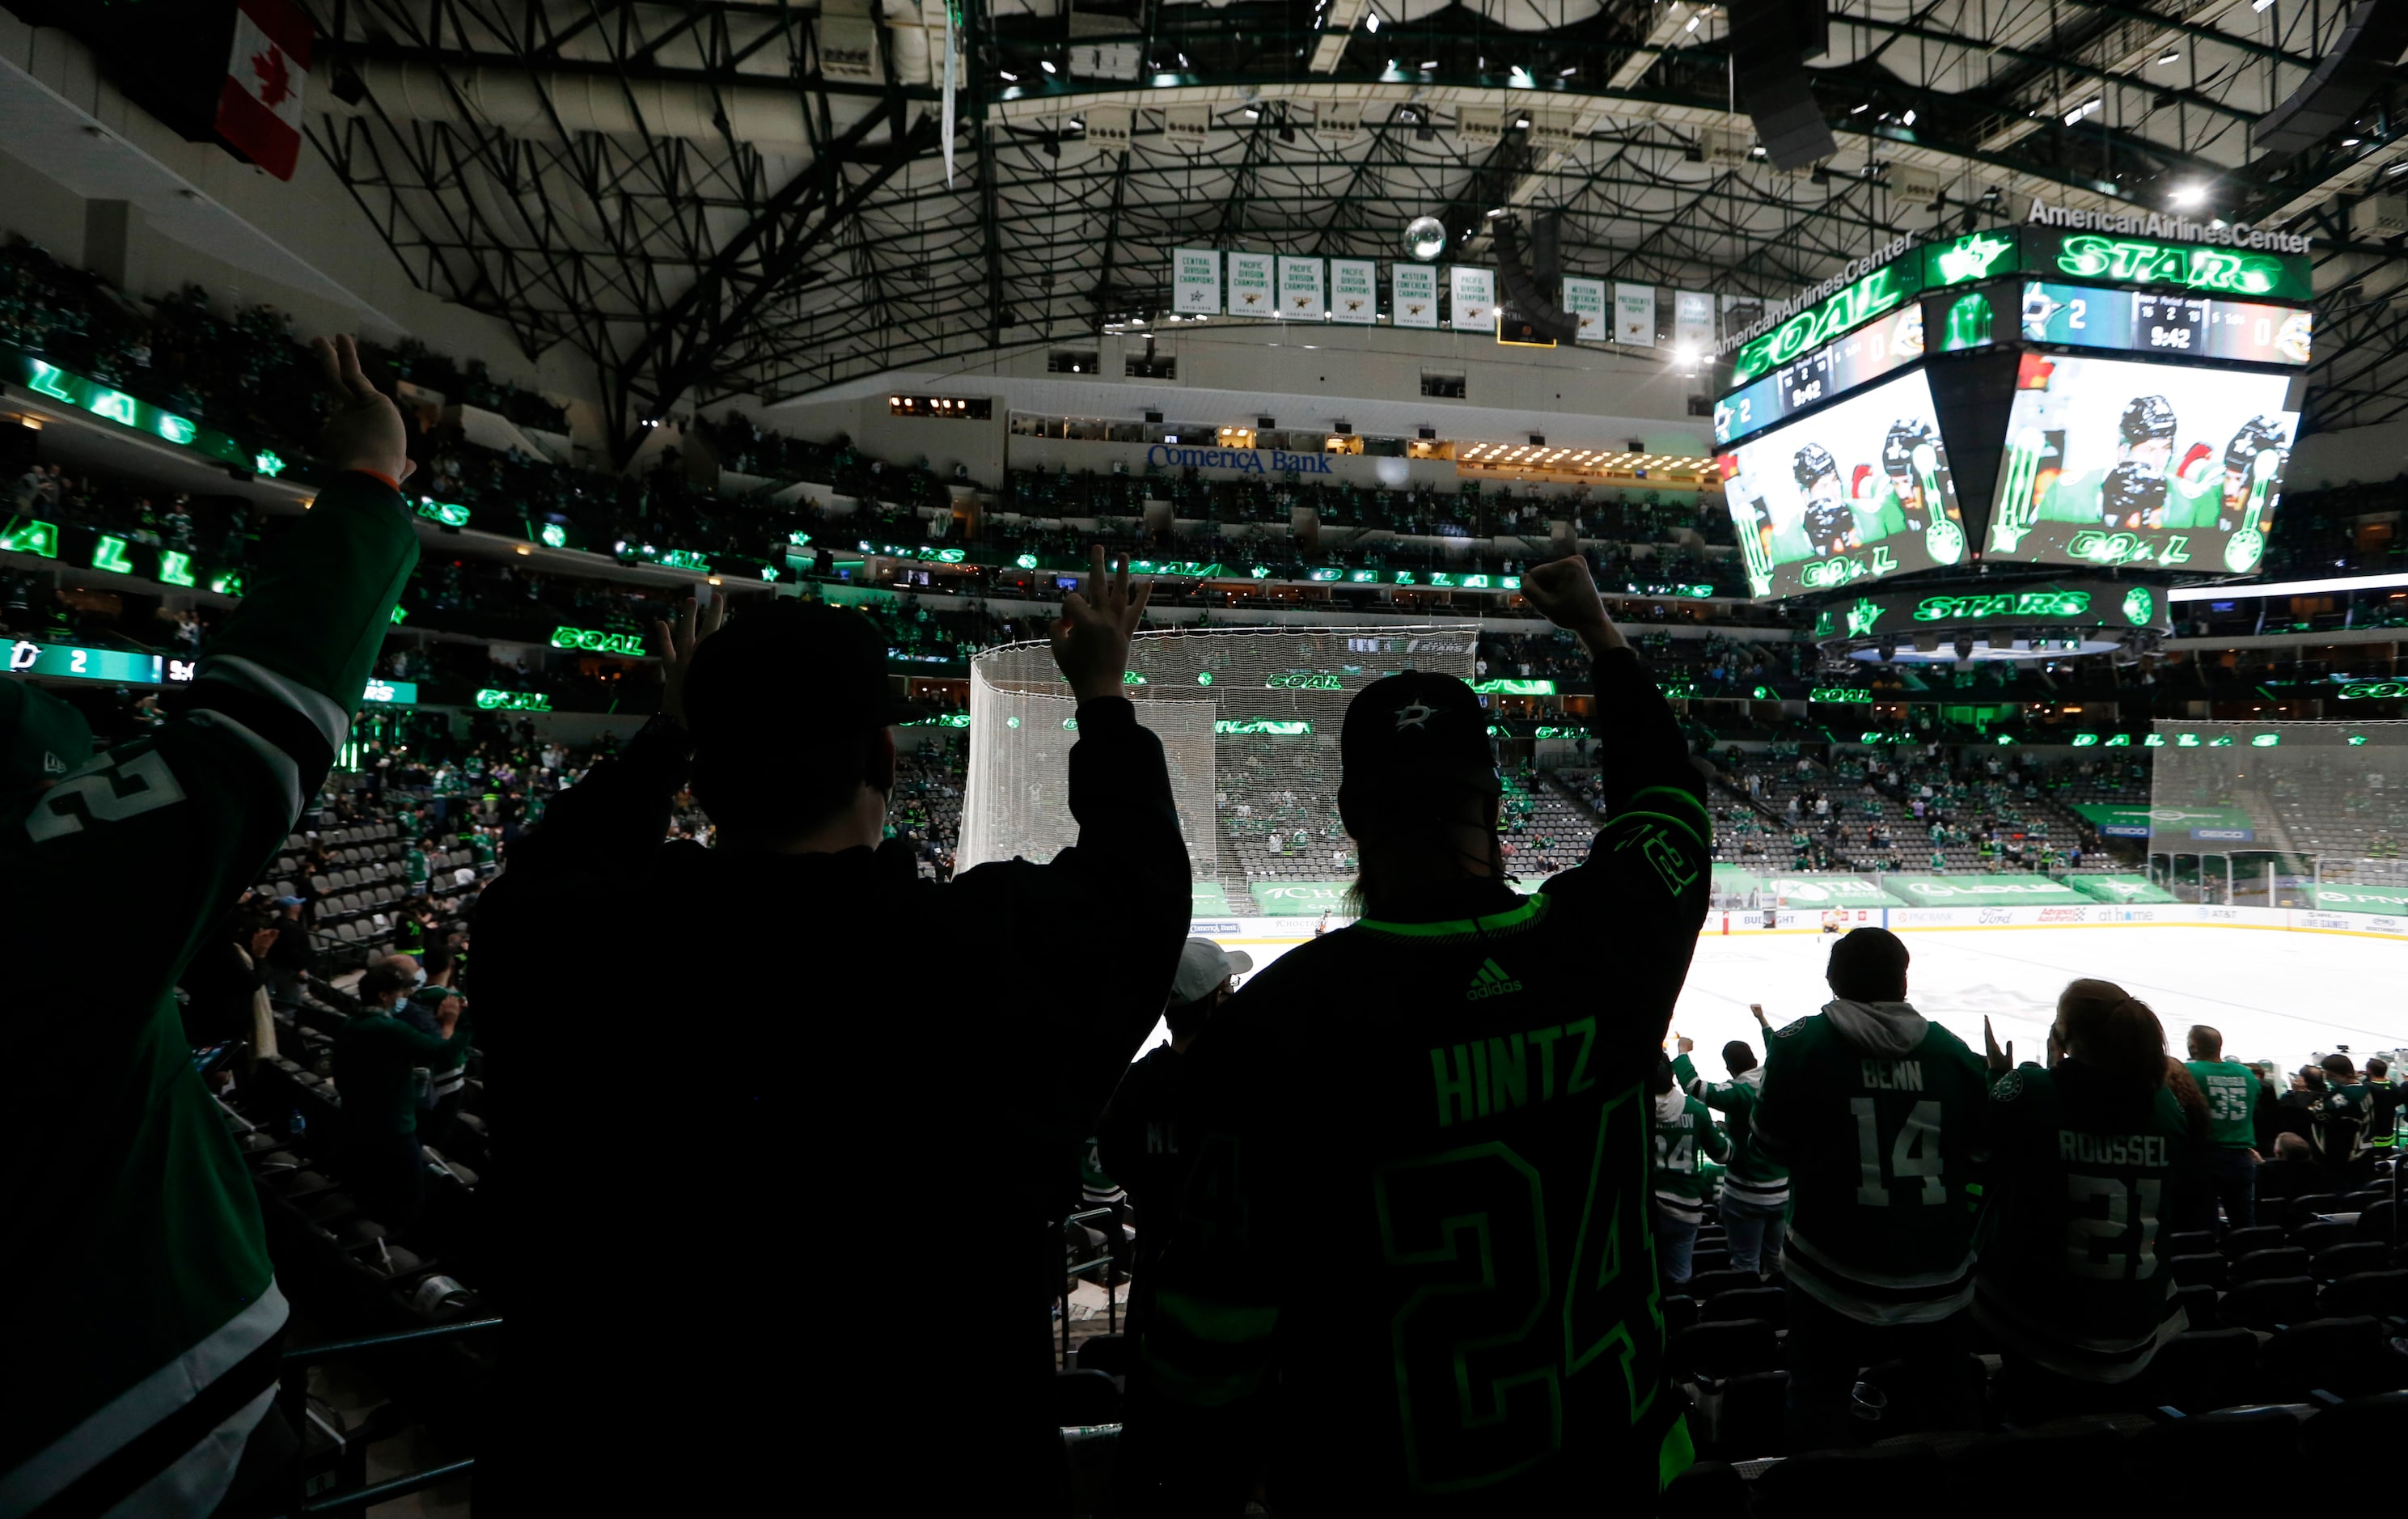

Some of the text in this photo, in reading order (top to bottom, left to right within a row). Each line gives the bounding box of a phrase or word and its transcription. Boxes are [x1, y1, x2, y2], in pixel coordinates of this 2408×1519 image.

[1183, 257, 1210, 266] CENTRAL
[1239, 260, 1263, 269] PACIFIC
[1289, 264, 1313, 273] PACIFIC
[2058, 235, 2283, 293] STARS
[1183, 266, 1210, 275] DIVISION
[1238, 269, 1263, 277] DIVISION
[1289, 273, 1314, 281] DIVISION
[1341, 267, 1365, 276] PACIFIC
[1401, 272, 1428, 281] WESTERN
[1179, 275, 1215, 285] CHAMPIONS
[1234, 278, 1268, 288] CHAMPIONS
[1284, 282, 1318, 292] CHAMPIONS
[1341, 277, 1366, 285] DIVISION
[1396, 281, 1433, 290] CONFERENCE
[1336, 286, 1370, 294] CHAMPIONS
[1399, 290, 1432, 298] CHAMPIONS
[1457, 293, 1489, 302] CHAMPIONS
[2069, 298, 2087, 329] 2
[2166, 307, 2176, 320] 2
[1736, 267, 1901, 380] GOAL
[2151, 326, 2191, 349] 9:42
[1740, 399, 1752, 424] 2
[1271, 451, 1333, 474] Bank
[1914, 591, 2092, 620] STARS
[551, 626, 645, 656] GOAL
[70, 649, 87, 673] 2
[1265, 673, 1344, 689] GOAL
[476, 689, 552, 712] GOAL
[1809, 688, 1873, 704] GOAL
[1535, 726, 1592, 739] GOAL
[1978, 908, 2012, 924] Ford
[2099, 910, 2113, 921] at
[2211, 910, 2237, 919] AT&T
[1221, 923, 1238, 932] Bank
[1466, 980, 1523, 1001] adidas
[1429, 1012, 1598, 1128] HINTZ
[1860, 1060, 1923, 1091] BENN
[2208, 1086, 2248, 1120] 35
[1850, 1098, 1947, 1206] 14
[2059, 1129, 2169, 1167] ROUSSEL
[2067, 1173, 2161, 1281] 21
[1373, 1081, 1666, 1496] 24
